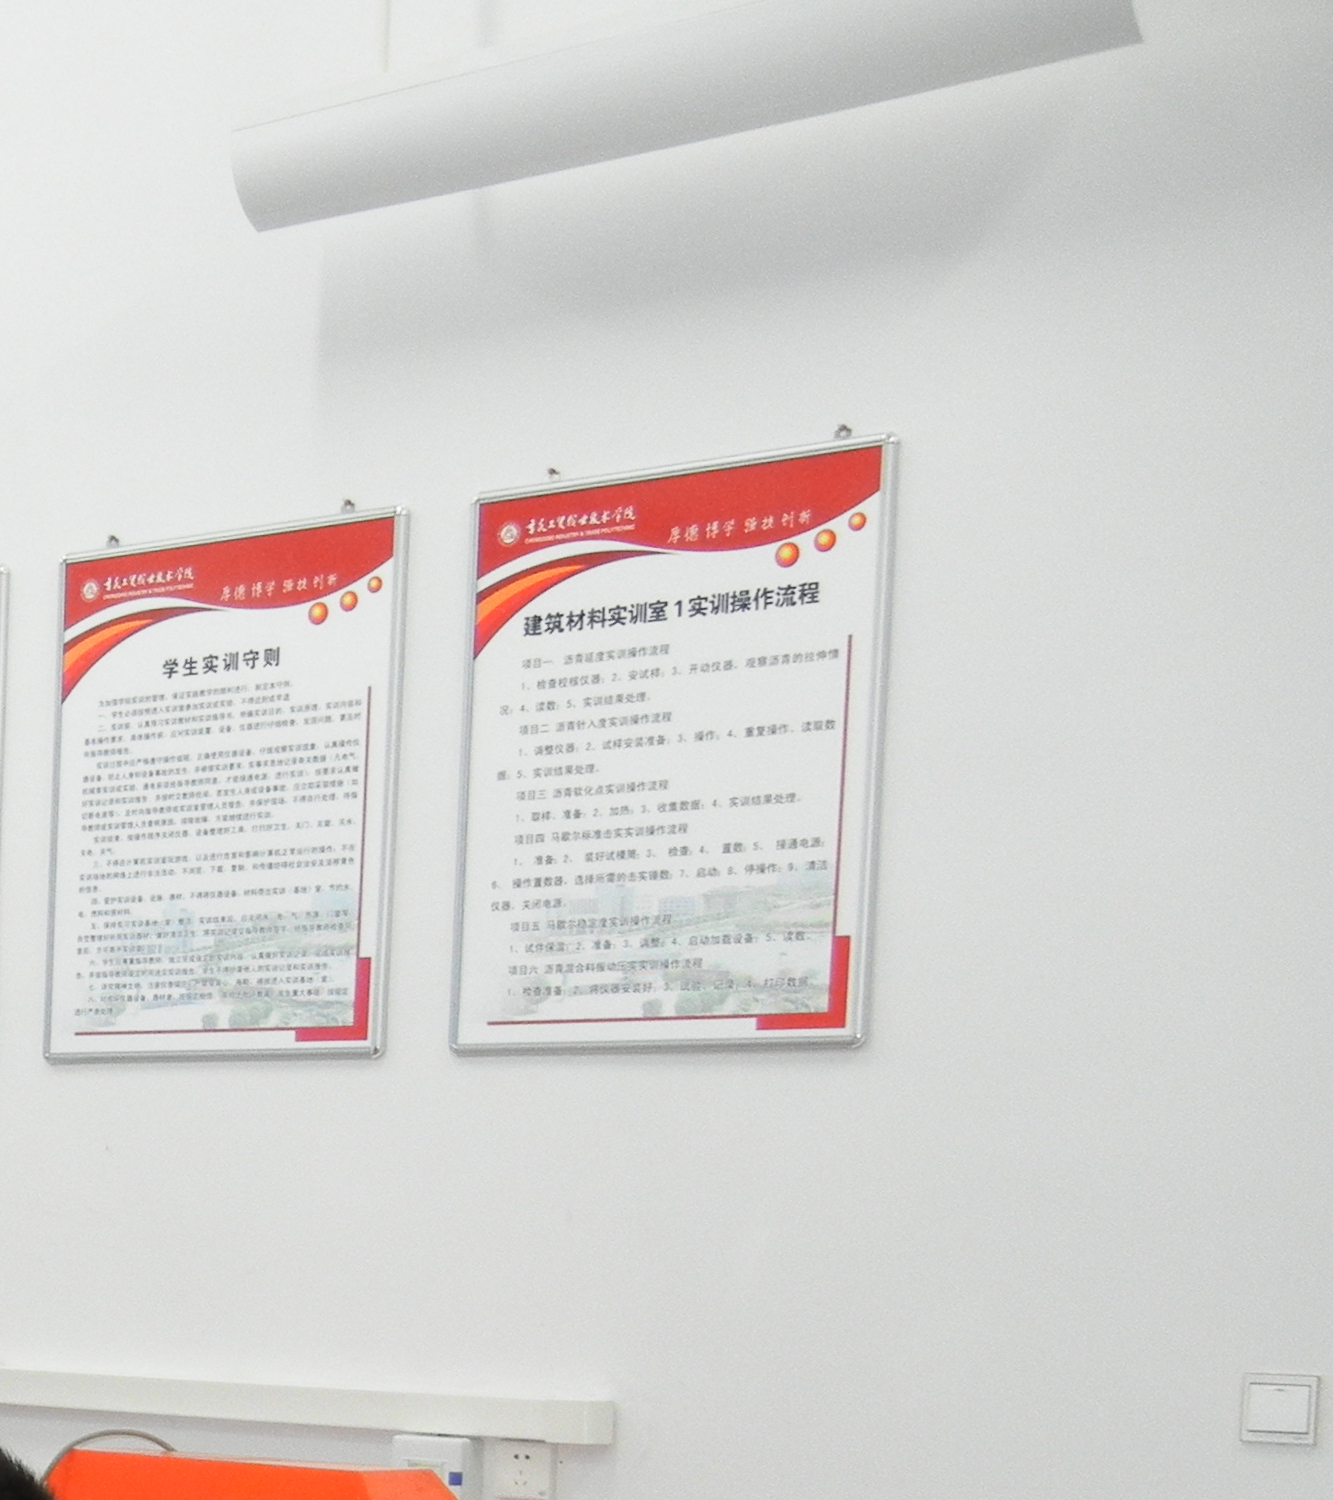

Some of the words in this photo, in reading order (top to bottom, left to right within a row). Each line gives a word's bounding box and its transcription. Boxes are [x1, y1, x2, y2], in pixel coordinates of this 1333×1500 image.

[521, 581, 821, 638] 建筑材料实训室1实训操作流程
[161, 646, 281, 680] 学生实训守则
